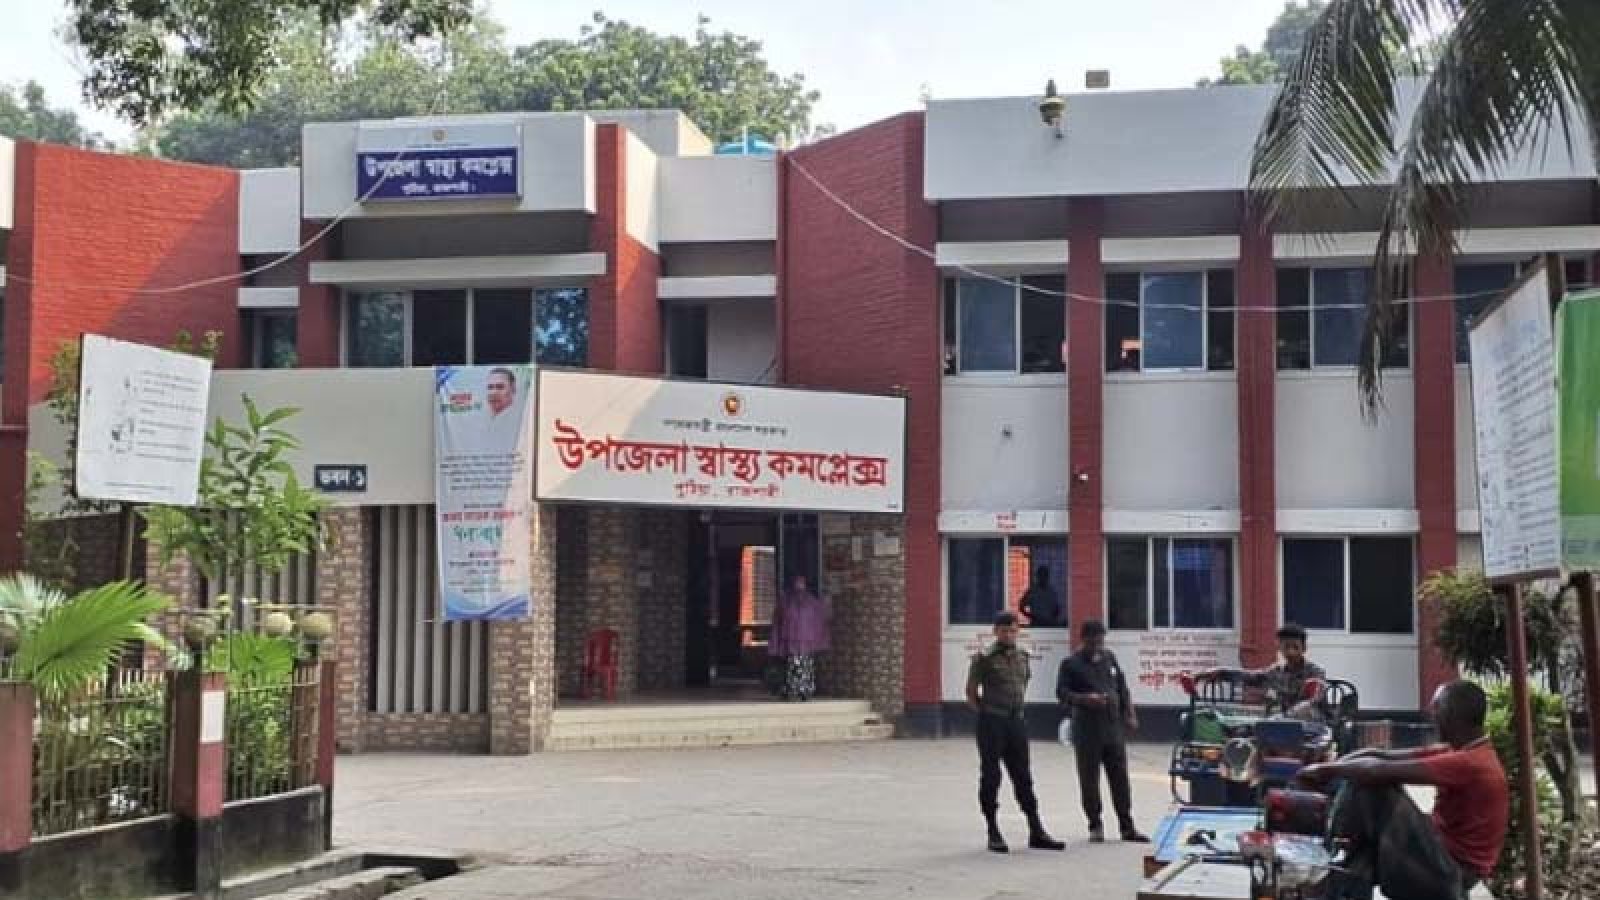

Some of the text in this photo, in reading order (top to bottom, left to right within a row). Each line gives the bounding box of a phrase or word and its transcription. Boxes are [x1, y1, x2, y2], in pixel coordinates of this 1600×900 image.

[366, 155, 421, 177] উপজেলা
[552, 417, 688, 475] উপজেলা
[693, 442, 761, 483] স্বাস্থ্য
[767, 450, 889, 487] কমপ্লেক্স
